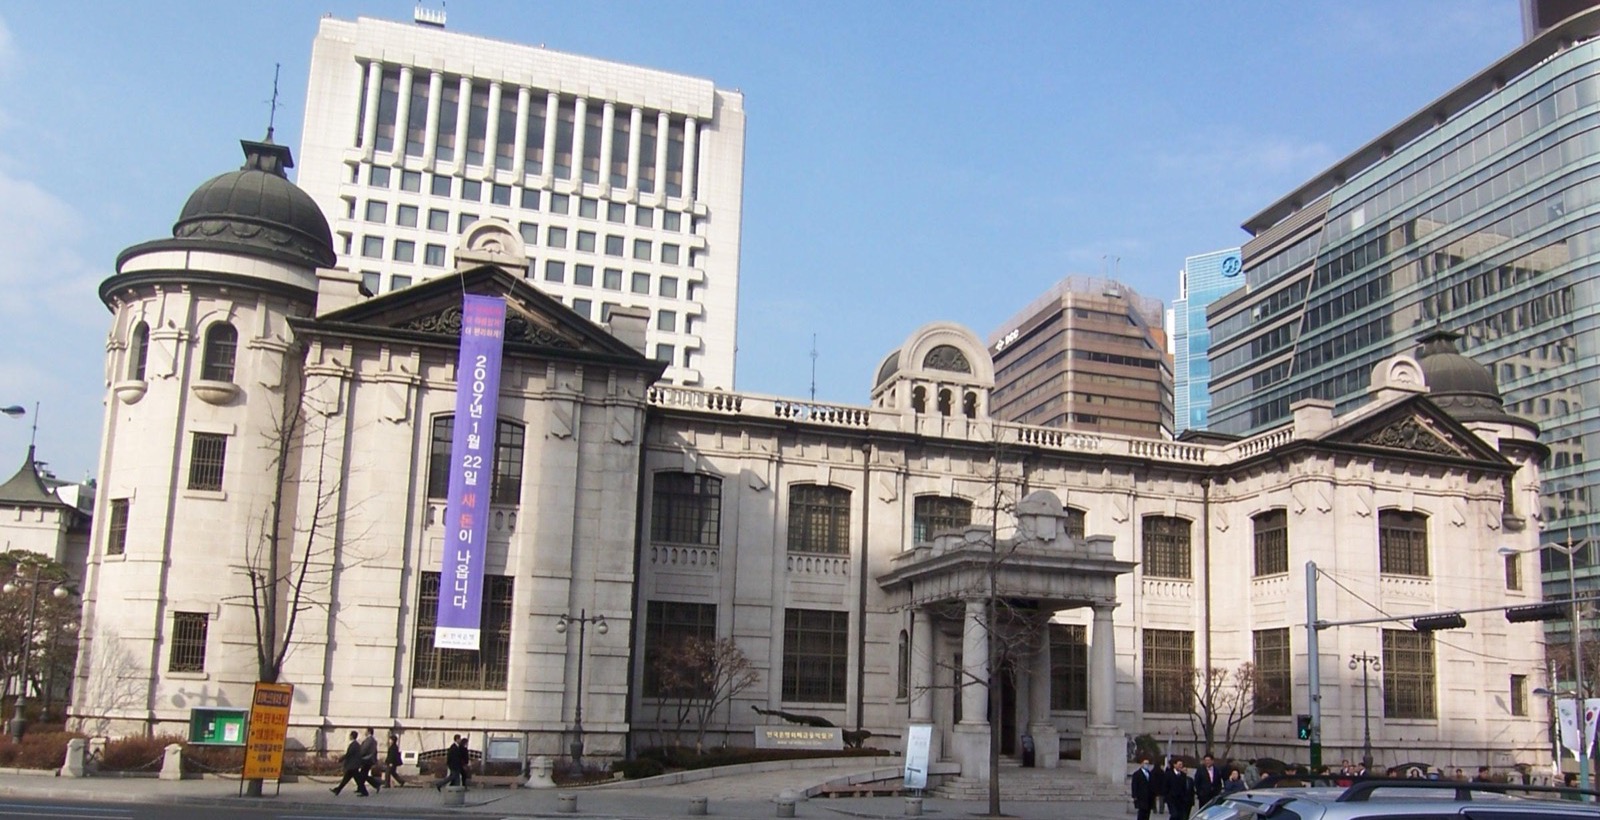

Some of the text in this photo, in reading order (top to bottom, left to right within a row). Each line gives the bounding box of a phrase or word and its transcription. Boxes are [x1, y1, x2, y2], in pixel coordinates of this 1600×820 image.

[453, 355, 487, 610] 2007년 1월 22일 새 돈이 나옵니다
